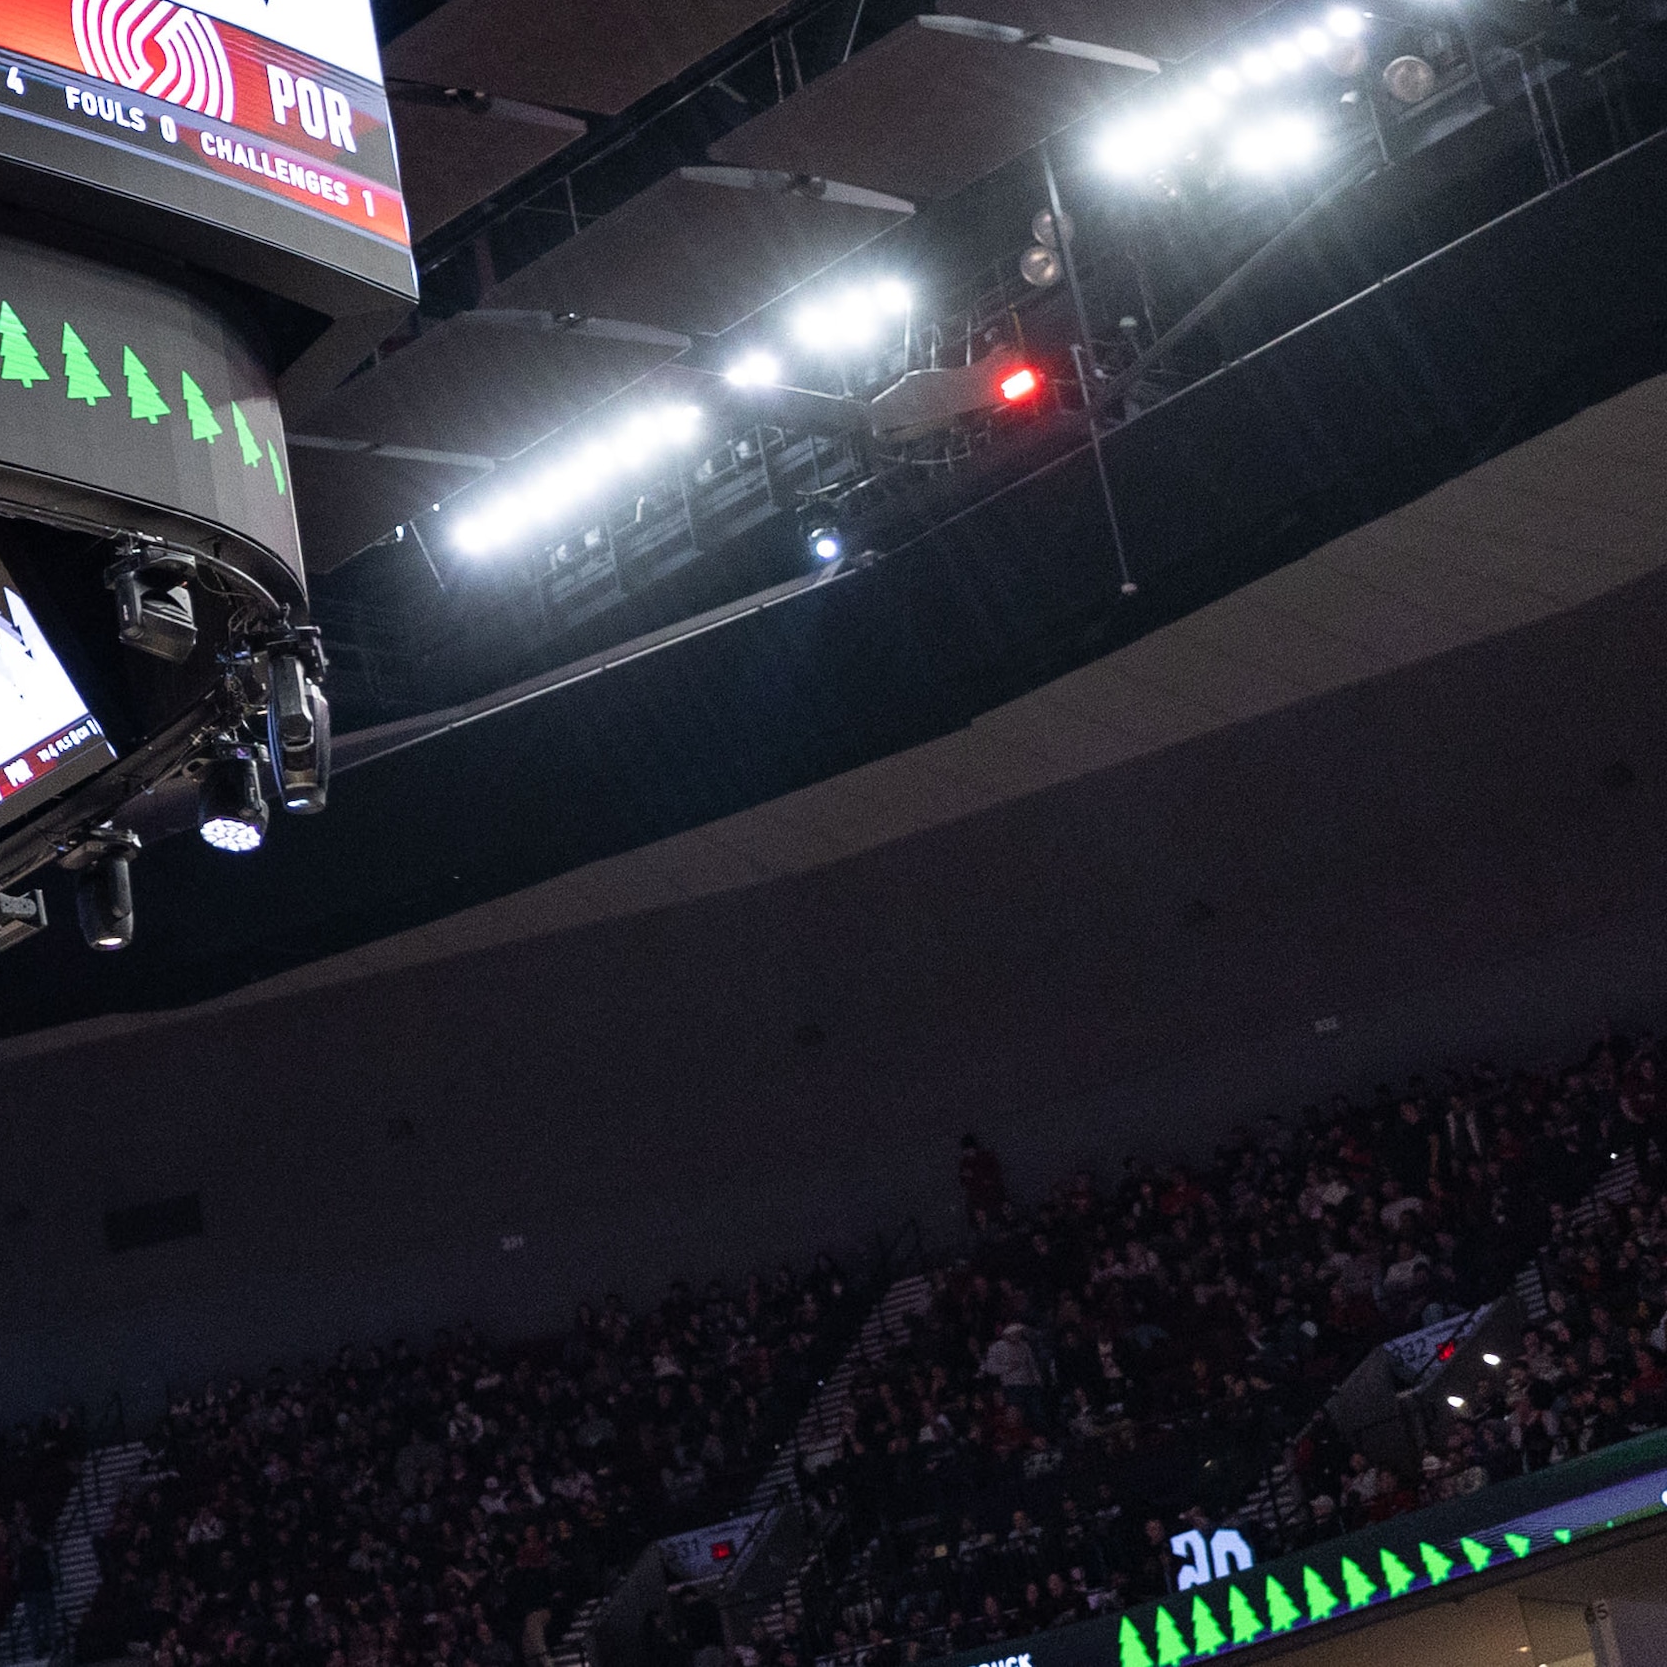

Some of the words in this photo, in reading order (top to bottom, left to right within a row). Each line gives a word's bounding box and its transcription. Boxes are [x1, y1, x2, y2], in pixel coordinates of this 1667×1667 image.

[6, 66, 25, 95] 4
[65, 85, 147, 134] FOULS
[160, 113, 178, 144] 0
[200, 131, 350, 208] CHALLENGES
[361, 189, 377, 219] 1
[266, 62, 358, 153] POR
